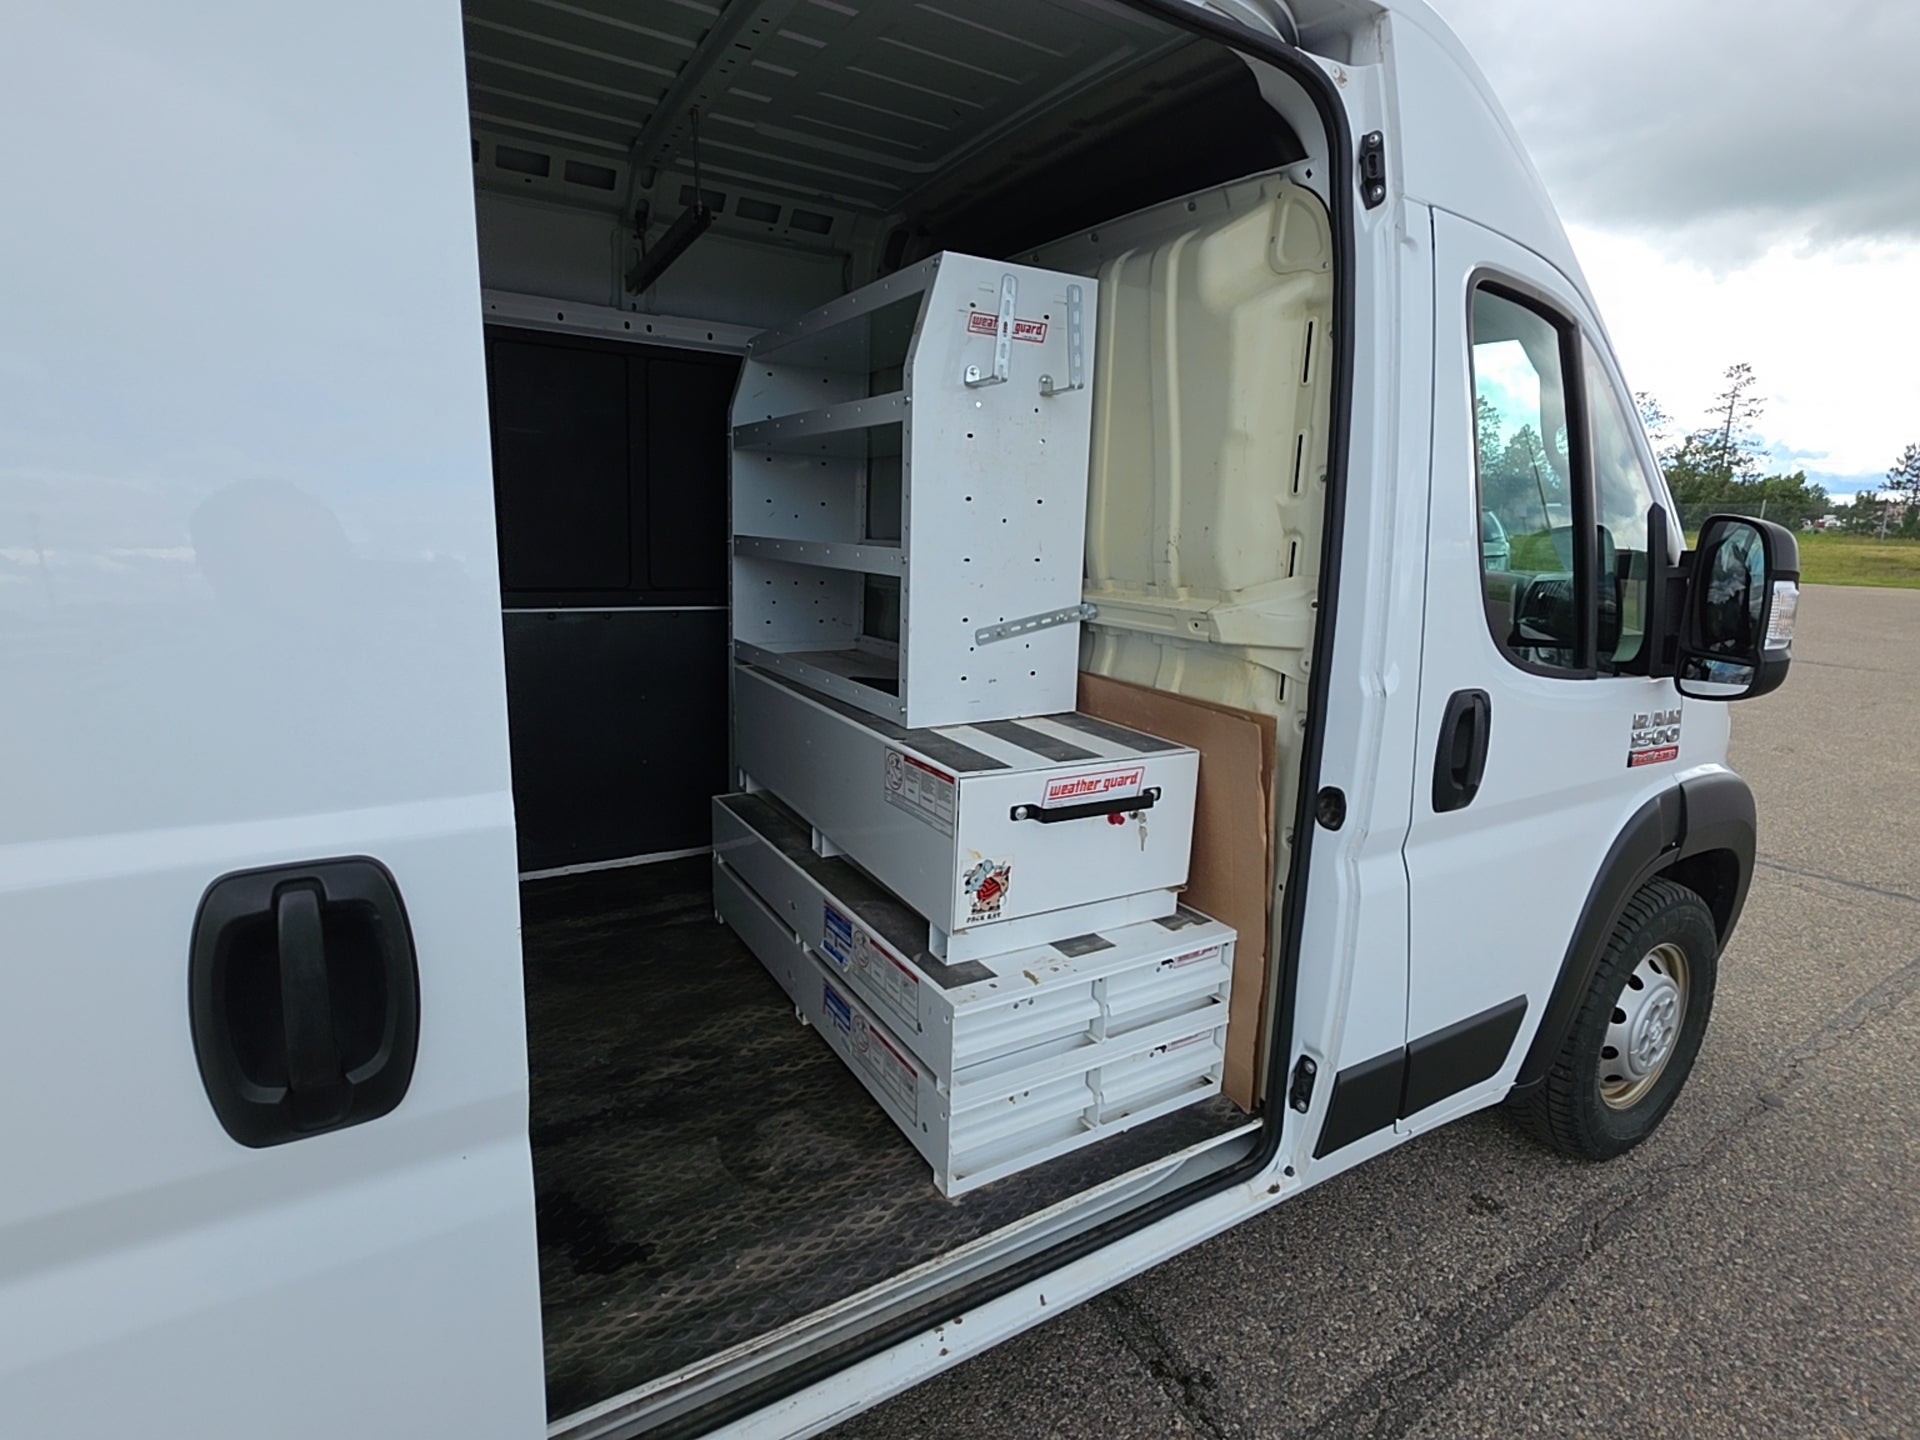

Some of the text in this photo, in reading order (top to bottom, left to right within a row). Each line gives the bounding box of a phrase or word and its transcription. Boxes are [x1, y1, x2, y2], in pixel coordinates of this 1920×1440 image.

[1014, 322, 1044, 336] guard
[1632, 709, 1682, 730] RAM
[1049, 771, 1139, 797] weather guard
